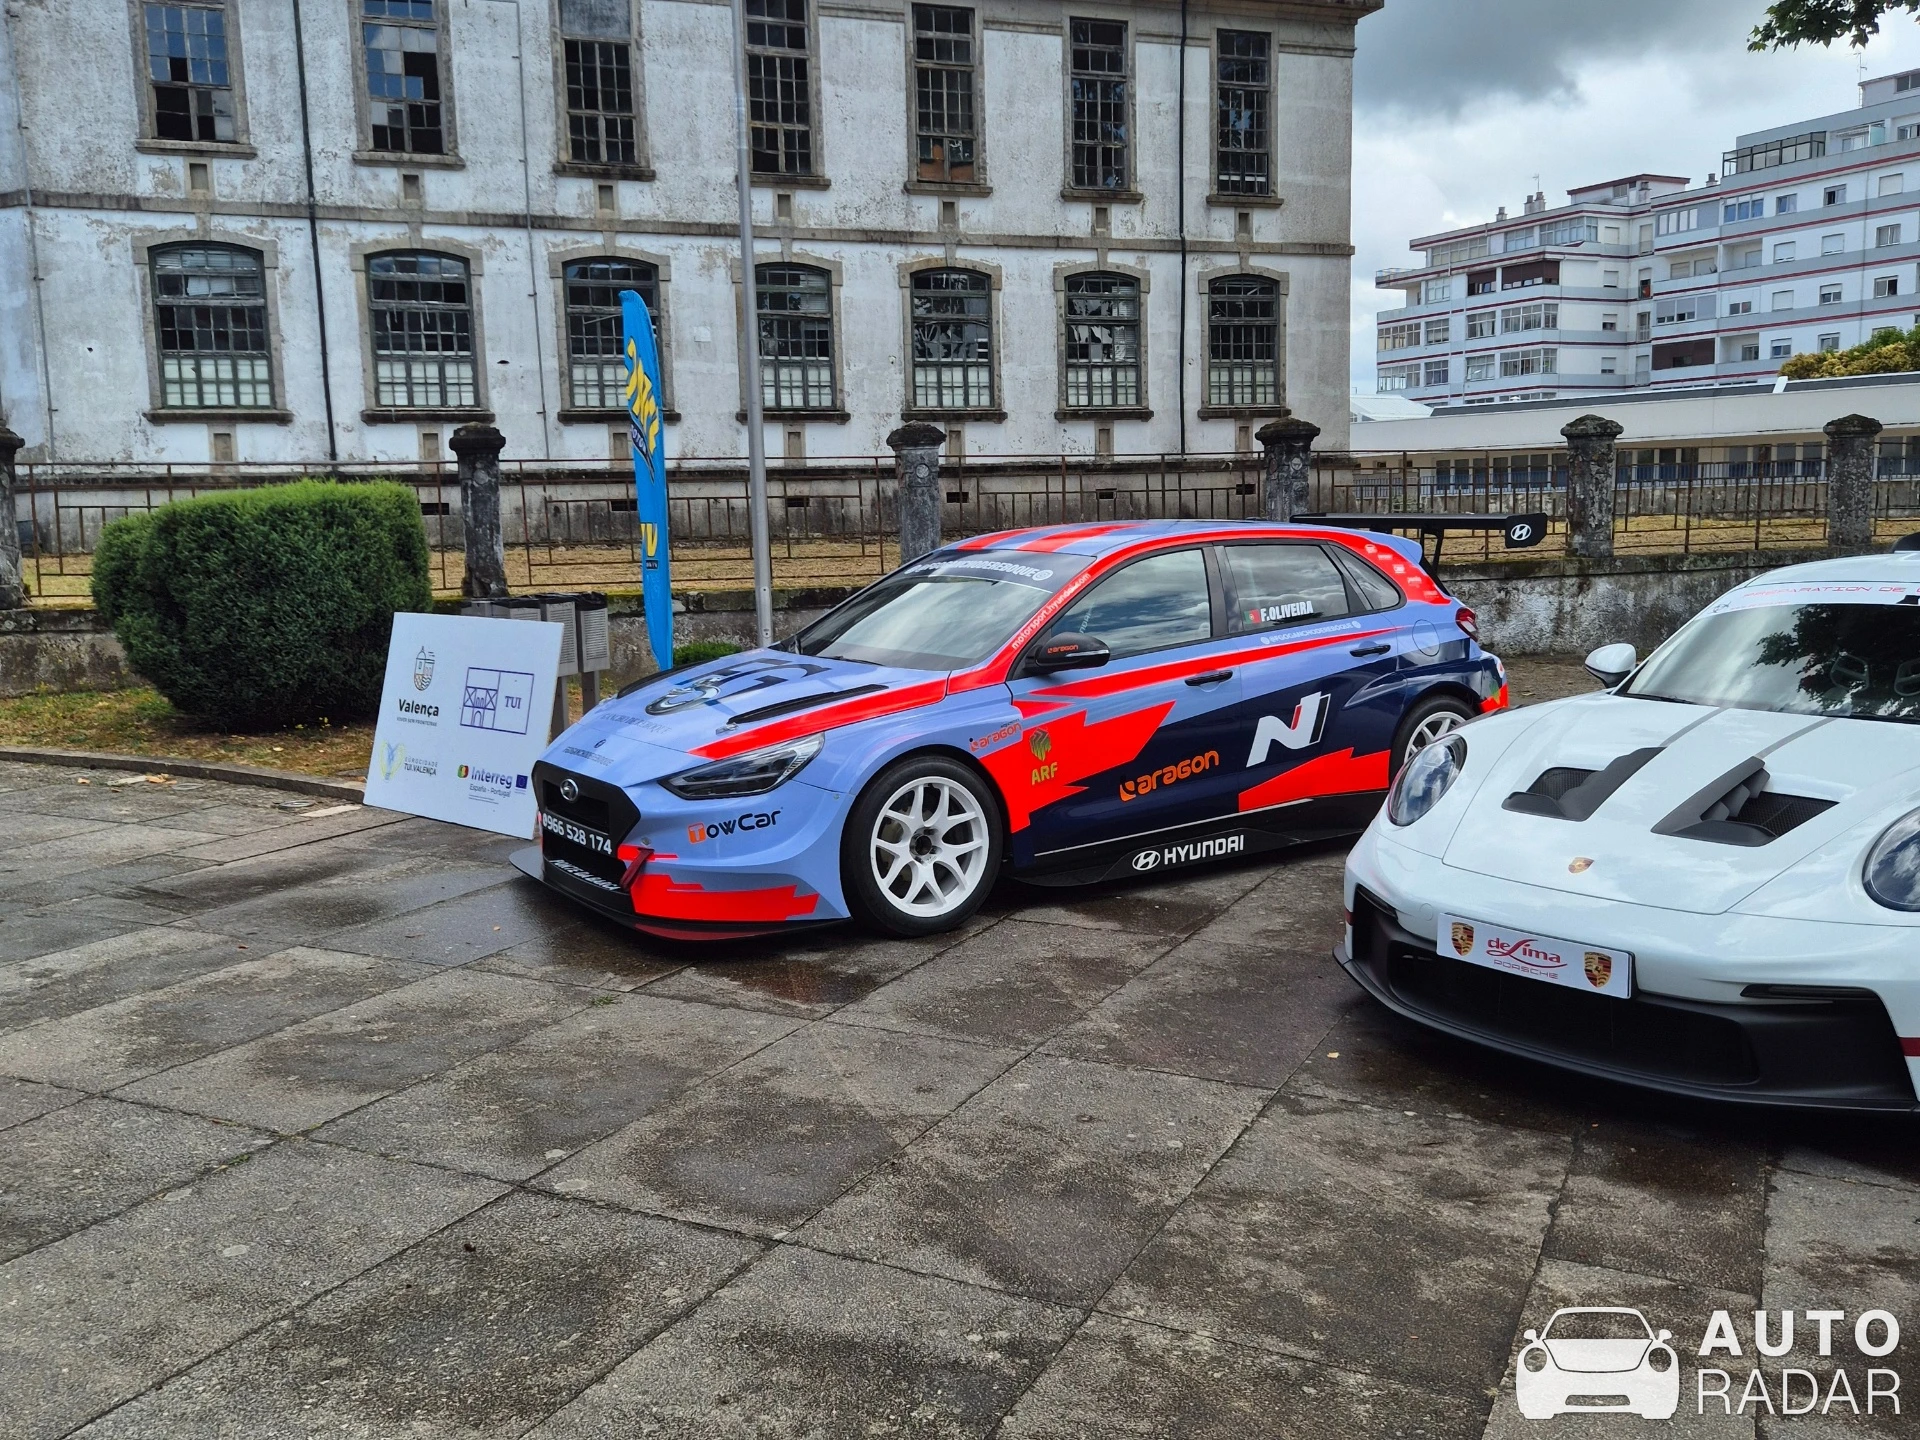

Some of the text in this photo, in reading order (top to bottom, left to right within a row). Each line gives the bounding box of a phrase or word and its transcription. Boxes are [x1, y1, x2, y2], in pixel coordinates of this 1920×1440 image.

[1742, 585, 1873, 598] PREPARATION
[1878, 586, 1907, 594] DE
[399, 698, 439, 718] Valença
[504, 695, 523, 709] TUI
[979, 723, 1022, 748] aragon
[471, 766, 513, 789] Interreg
[1031, 761, 1058, 785] ARF
[1137, 748, 1220, 795] aragon
[688, 810, 781, 844] TowCar
[566, 824, 587, 845] 528
[589, 834, 612, 855] 174
[1163, 833, 1245, 865] HYUNDAI
[1493, 959, 1559, 980] PORSCHE
